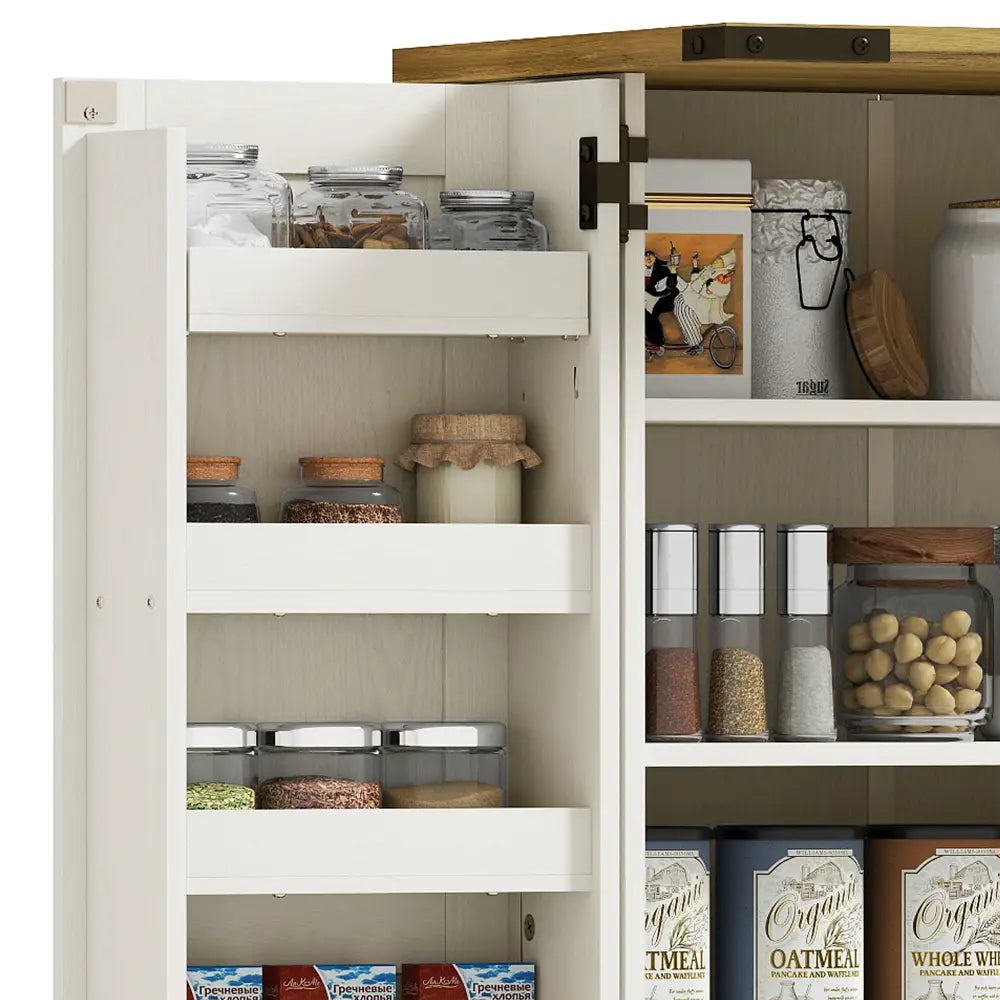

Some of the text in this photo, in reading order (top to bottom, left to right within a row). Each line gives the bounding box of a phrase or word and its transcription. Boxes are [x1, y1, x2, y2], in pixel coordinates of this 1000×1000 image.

[645, 950, 706, 971] TMEAL
[770, 949, 859, 969] OATMEAL
[912, 951, 971, 967] WHOLE
[920, 969, 975, 977] PANCAKE AND
[200, 986, 258, 997] Гречневые
[333, 985, 392, 996] Гречневые
[472, 983, 531, 994] Гречневые
[492, 993, 530, 1000] хлопья
